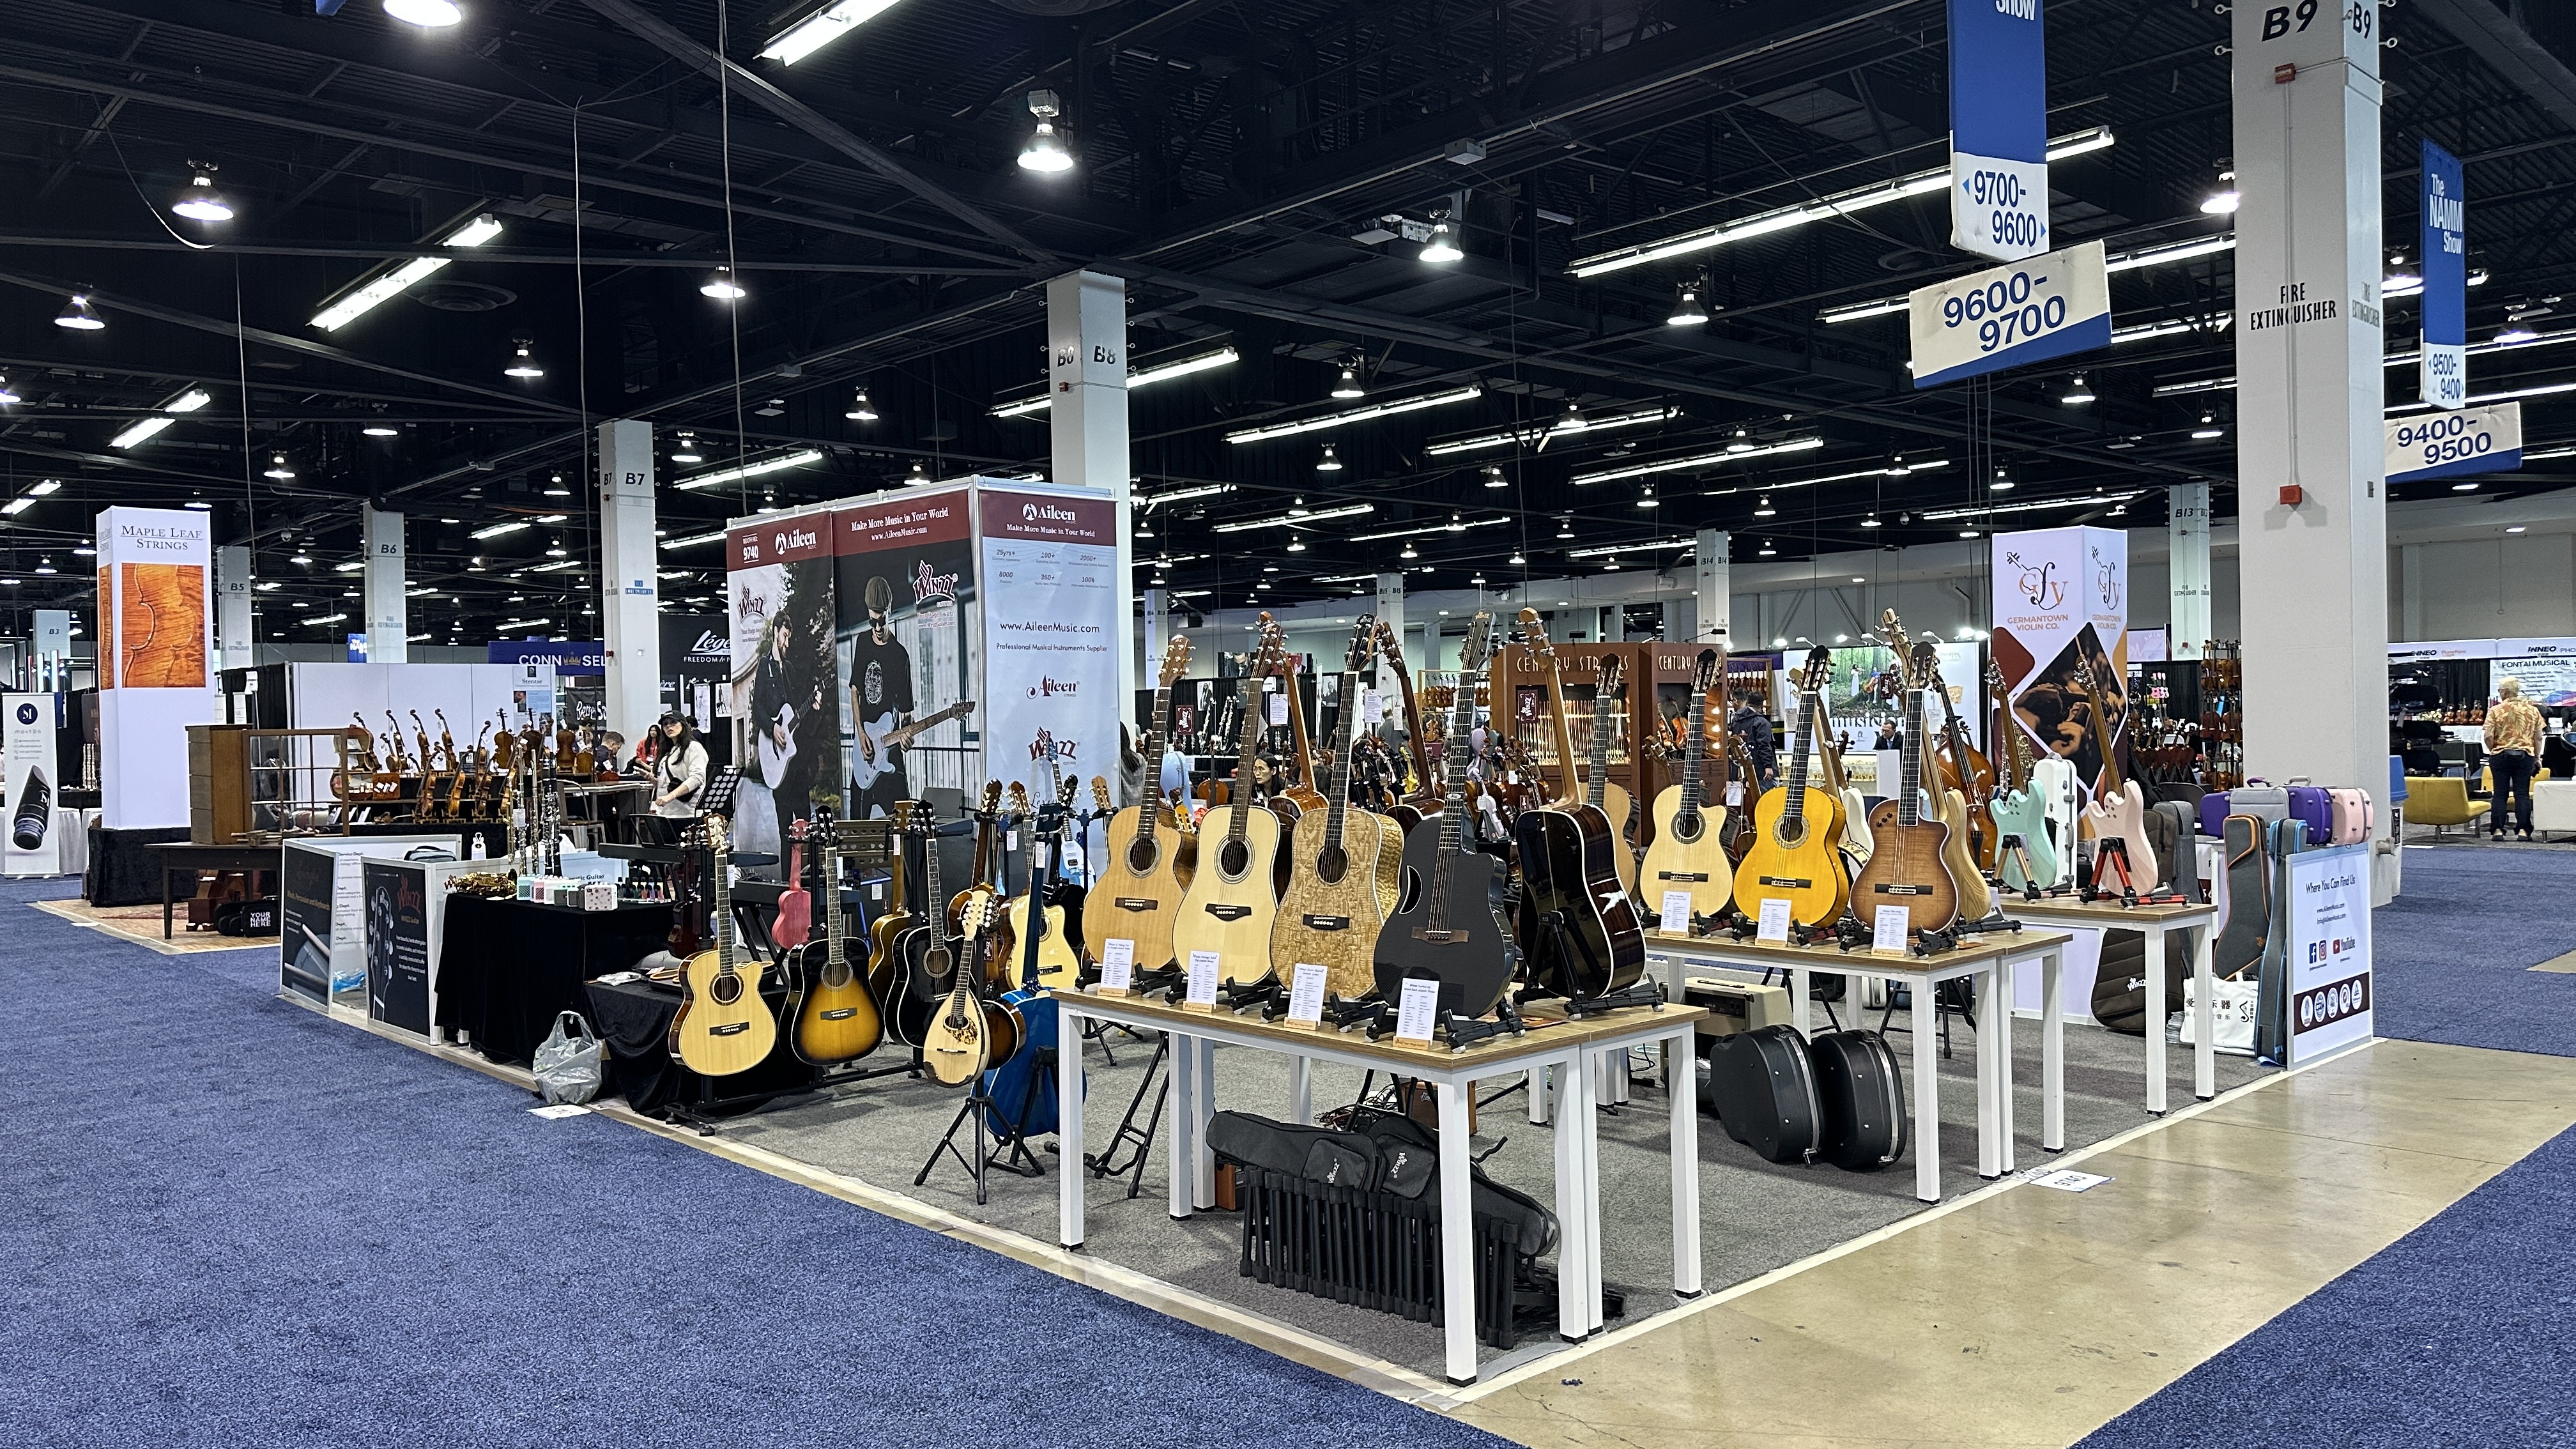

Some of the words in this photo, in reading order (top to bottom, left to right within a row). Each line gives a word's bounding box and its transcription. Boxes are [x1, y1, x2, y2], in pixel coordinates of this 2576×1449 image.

[2262, 0, 2318, 42] B9
[2353, 1, 2371, 39] B9
[1974, 170, 2026, 208] 9700-
[2432, 173, 2444, 197] The
[2429, 195, 2463, 233] NAMM
[1992, 210, 2037, 247] 9600
[2443, 231, 2462, 254] Show
[1943, 272, 2048, 328] 9600-
[2280, 282, 2305, 304] FIRE
[1979, 295, 2066, 352] 9700
[2251, 300, 2336, 330] EXTINGUISHER
[1094, 346, 1116, 364] B8
[2433, 353, 2457, 376] 9500-
[2441, 377, 2460, 399] 9400
[2397, 415, 2478, 447] 9400-
[2424, 431, 2492, 465] 9500
[604, 472, 612, 486] B7
[625, 472, 645, 486] B7
[851, 521, 867, 531] Make
[868, 519, 884, 529] More
[885, 516, 903, 526] Music
[904, 514, 910, 523] in
[912, 512, 927, 521] Your
[928, 507, 949, 519] World
[1038, 505, 1076, 521] Aileen
[2175, 508, 2193, 518] B13
[121, 526, 165, 537] MAPLE
[171, 528, 203, 538] LEAF
[787, 528, 816, 549] Aileen
[871, 526, 927, 540] www.AileenMusic.com
[137, 539, 188, 550] STRINGS
[381, 544, 397, 553] B6
[743, 546, 759, 560] 9740
[1000, 622, 1100, 633] www.AileenMusic.com
[2007, 615, 2069, 624] GERMANTOWN
[519, 655, 562, 666] CONN
[1517, 656, 1570, 672] CENRY
[1579, 655, 1629, 671] STRS
[1659, 655, 1690, 670] CENTURY
[1026, 675, 1077, 699] Aileen
[2306, 882, 2320, 894] Where
[2321, 880, 2330, 891] You
[2331, 878, 2340, 889] Can
[2185, 997, 2231, 1009] 爱乐器
